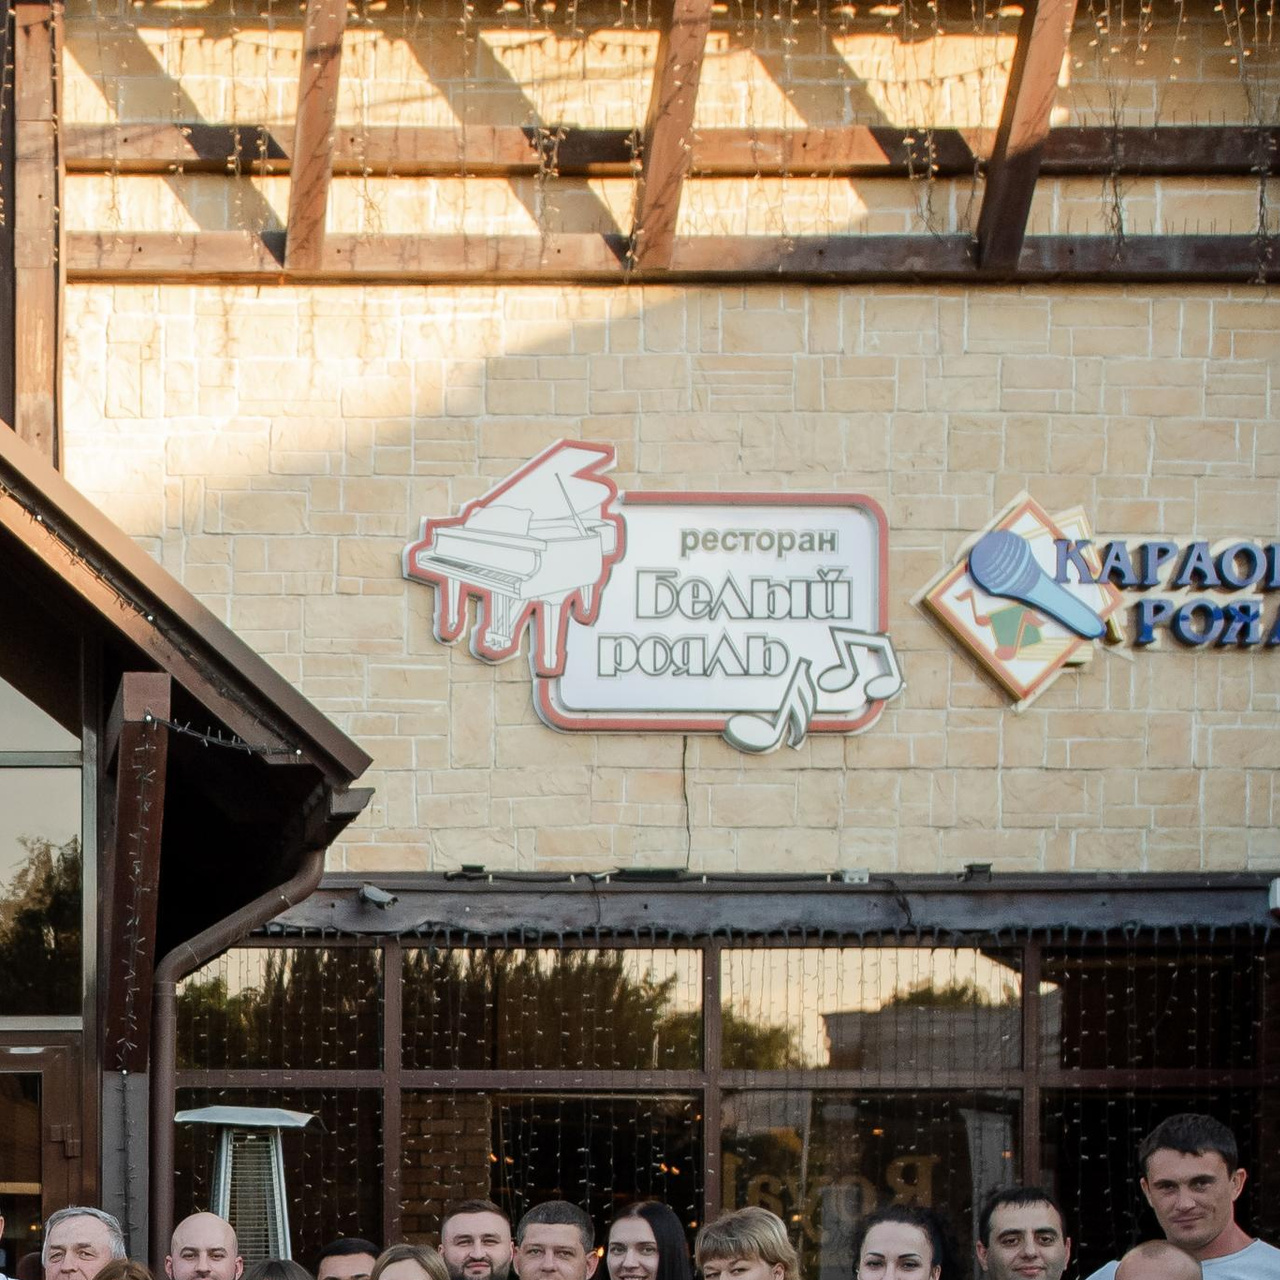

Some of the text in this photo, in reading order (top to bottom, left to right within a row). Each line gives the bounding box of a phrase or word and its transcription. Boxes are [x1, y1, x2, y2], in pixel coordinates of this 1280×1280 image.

[680, 530, 837, 559] ресторан
[1053, 539, 1280, 588] КАРАО
[636, 567, 853, 620] Белый
[1136, 599, 1280, 645] РОЯ
[597, 628, 789, 677] рояль
